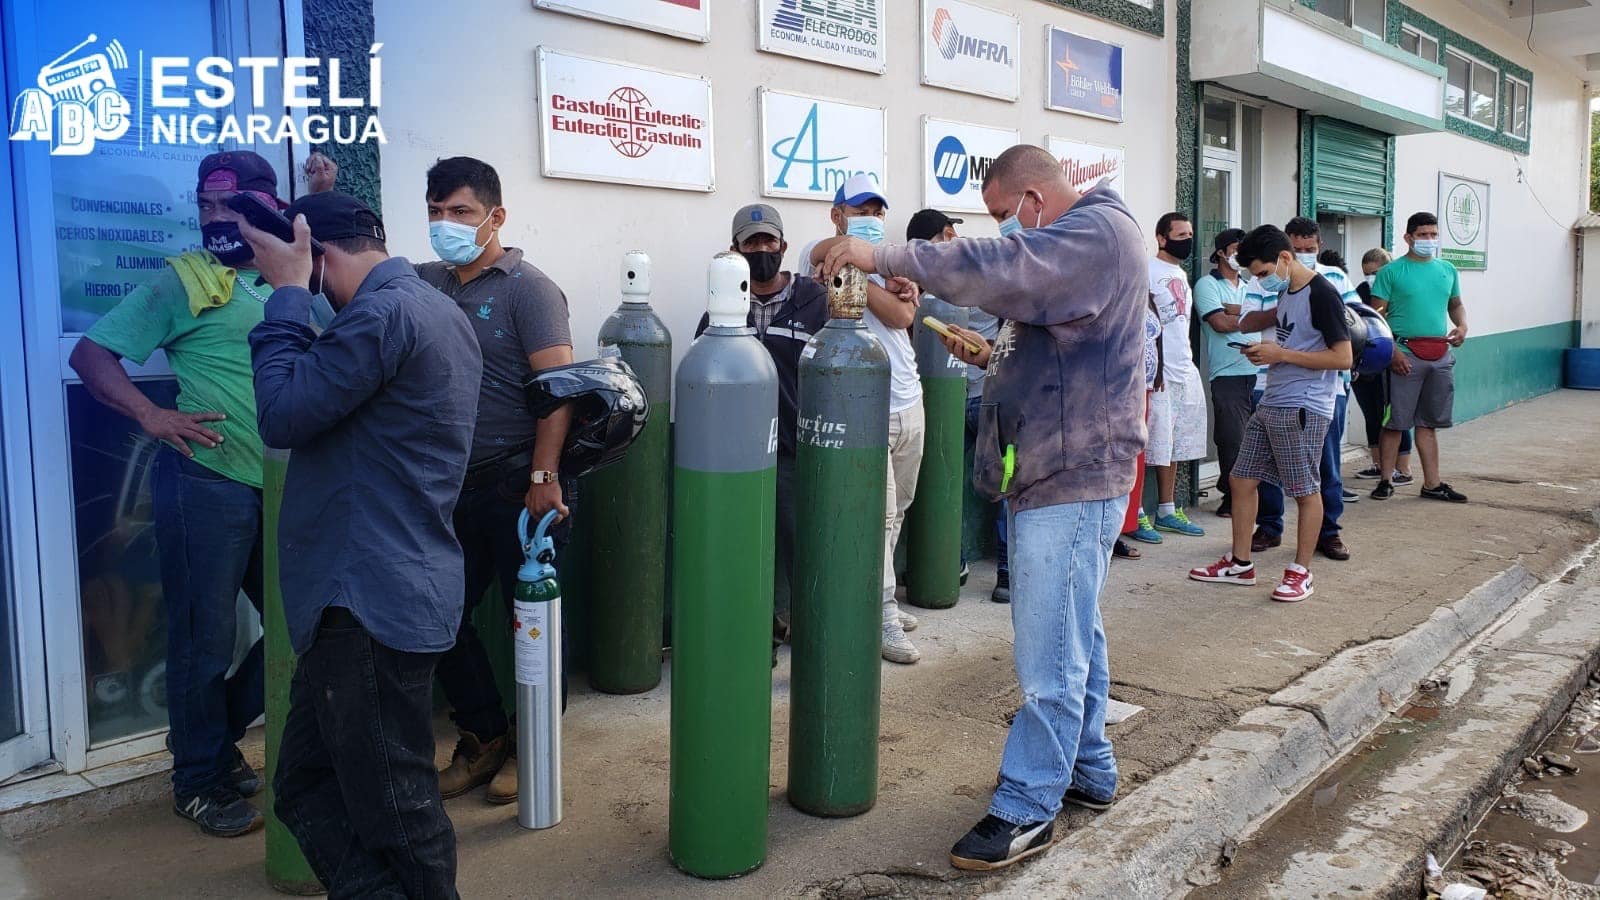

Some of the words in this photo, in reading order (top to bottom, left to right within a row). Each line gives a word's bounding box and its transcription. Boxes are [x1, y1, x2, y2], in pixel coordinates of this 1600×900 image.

[805, 17, 878, 46] ELECTRODOS
[811, 38, 840, 52] CALIDAD
[841, 43, 846, 53] Y
[957, 34, 1009, 65] INFRA
[551, 94, 627, 119] Castolin
[634, 106, 701, 130] Eutectic
[551, 114, 628, 140] Eutectic
[635, 126, 702, 149] Castolin
[1060, 154, 1118, 187] Milwaukee
[71, 196, 163, 216] CONVENCIONALES
[97, 227, 165, 243] INOXIDABLES
[84, 282, 121, 297] HIERRO
